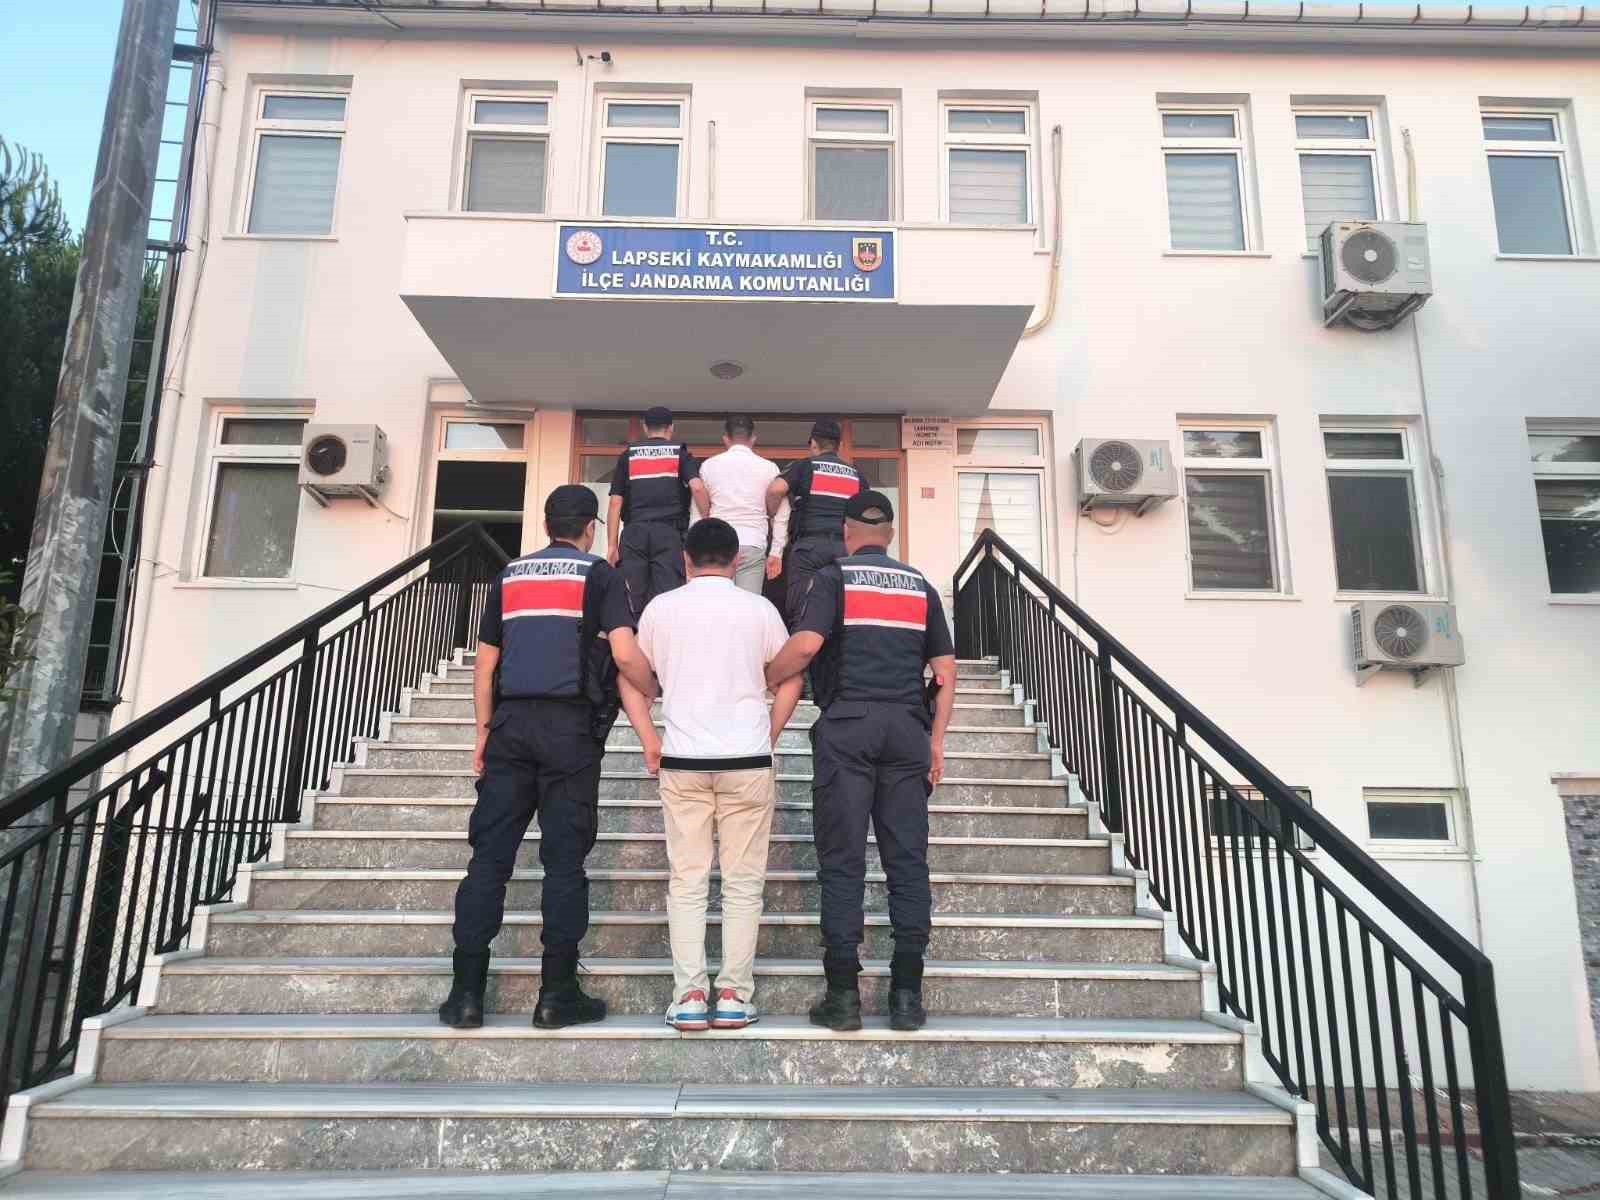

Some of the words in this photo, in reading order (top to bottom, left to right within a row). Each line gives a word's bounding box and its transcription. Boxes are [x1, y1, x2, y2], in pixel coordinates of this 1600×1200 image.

[706, 231, 743, 246] T.C.
[612, 248, 691, 266] LAPSEKİ
[698, 251, 842, 269] KAYMAKAMLIĞI
[581, 268, 624, 291] İLÇE
[630, 273, 734, 290] JANDARMA
[740, 274, 871, 292] KOMUTANLIĞI
[634, 447, 674, 456] JANDARMA
[817, 463, 855, 476] JANDARMA
[510, 561, 578, 577] JANDARMA
[852, 570, 919, 591] JANDARMA
